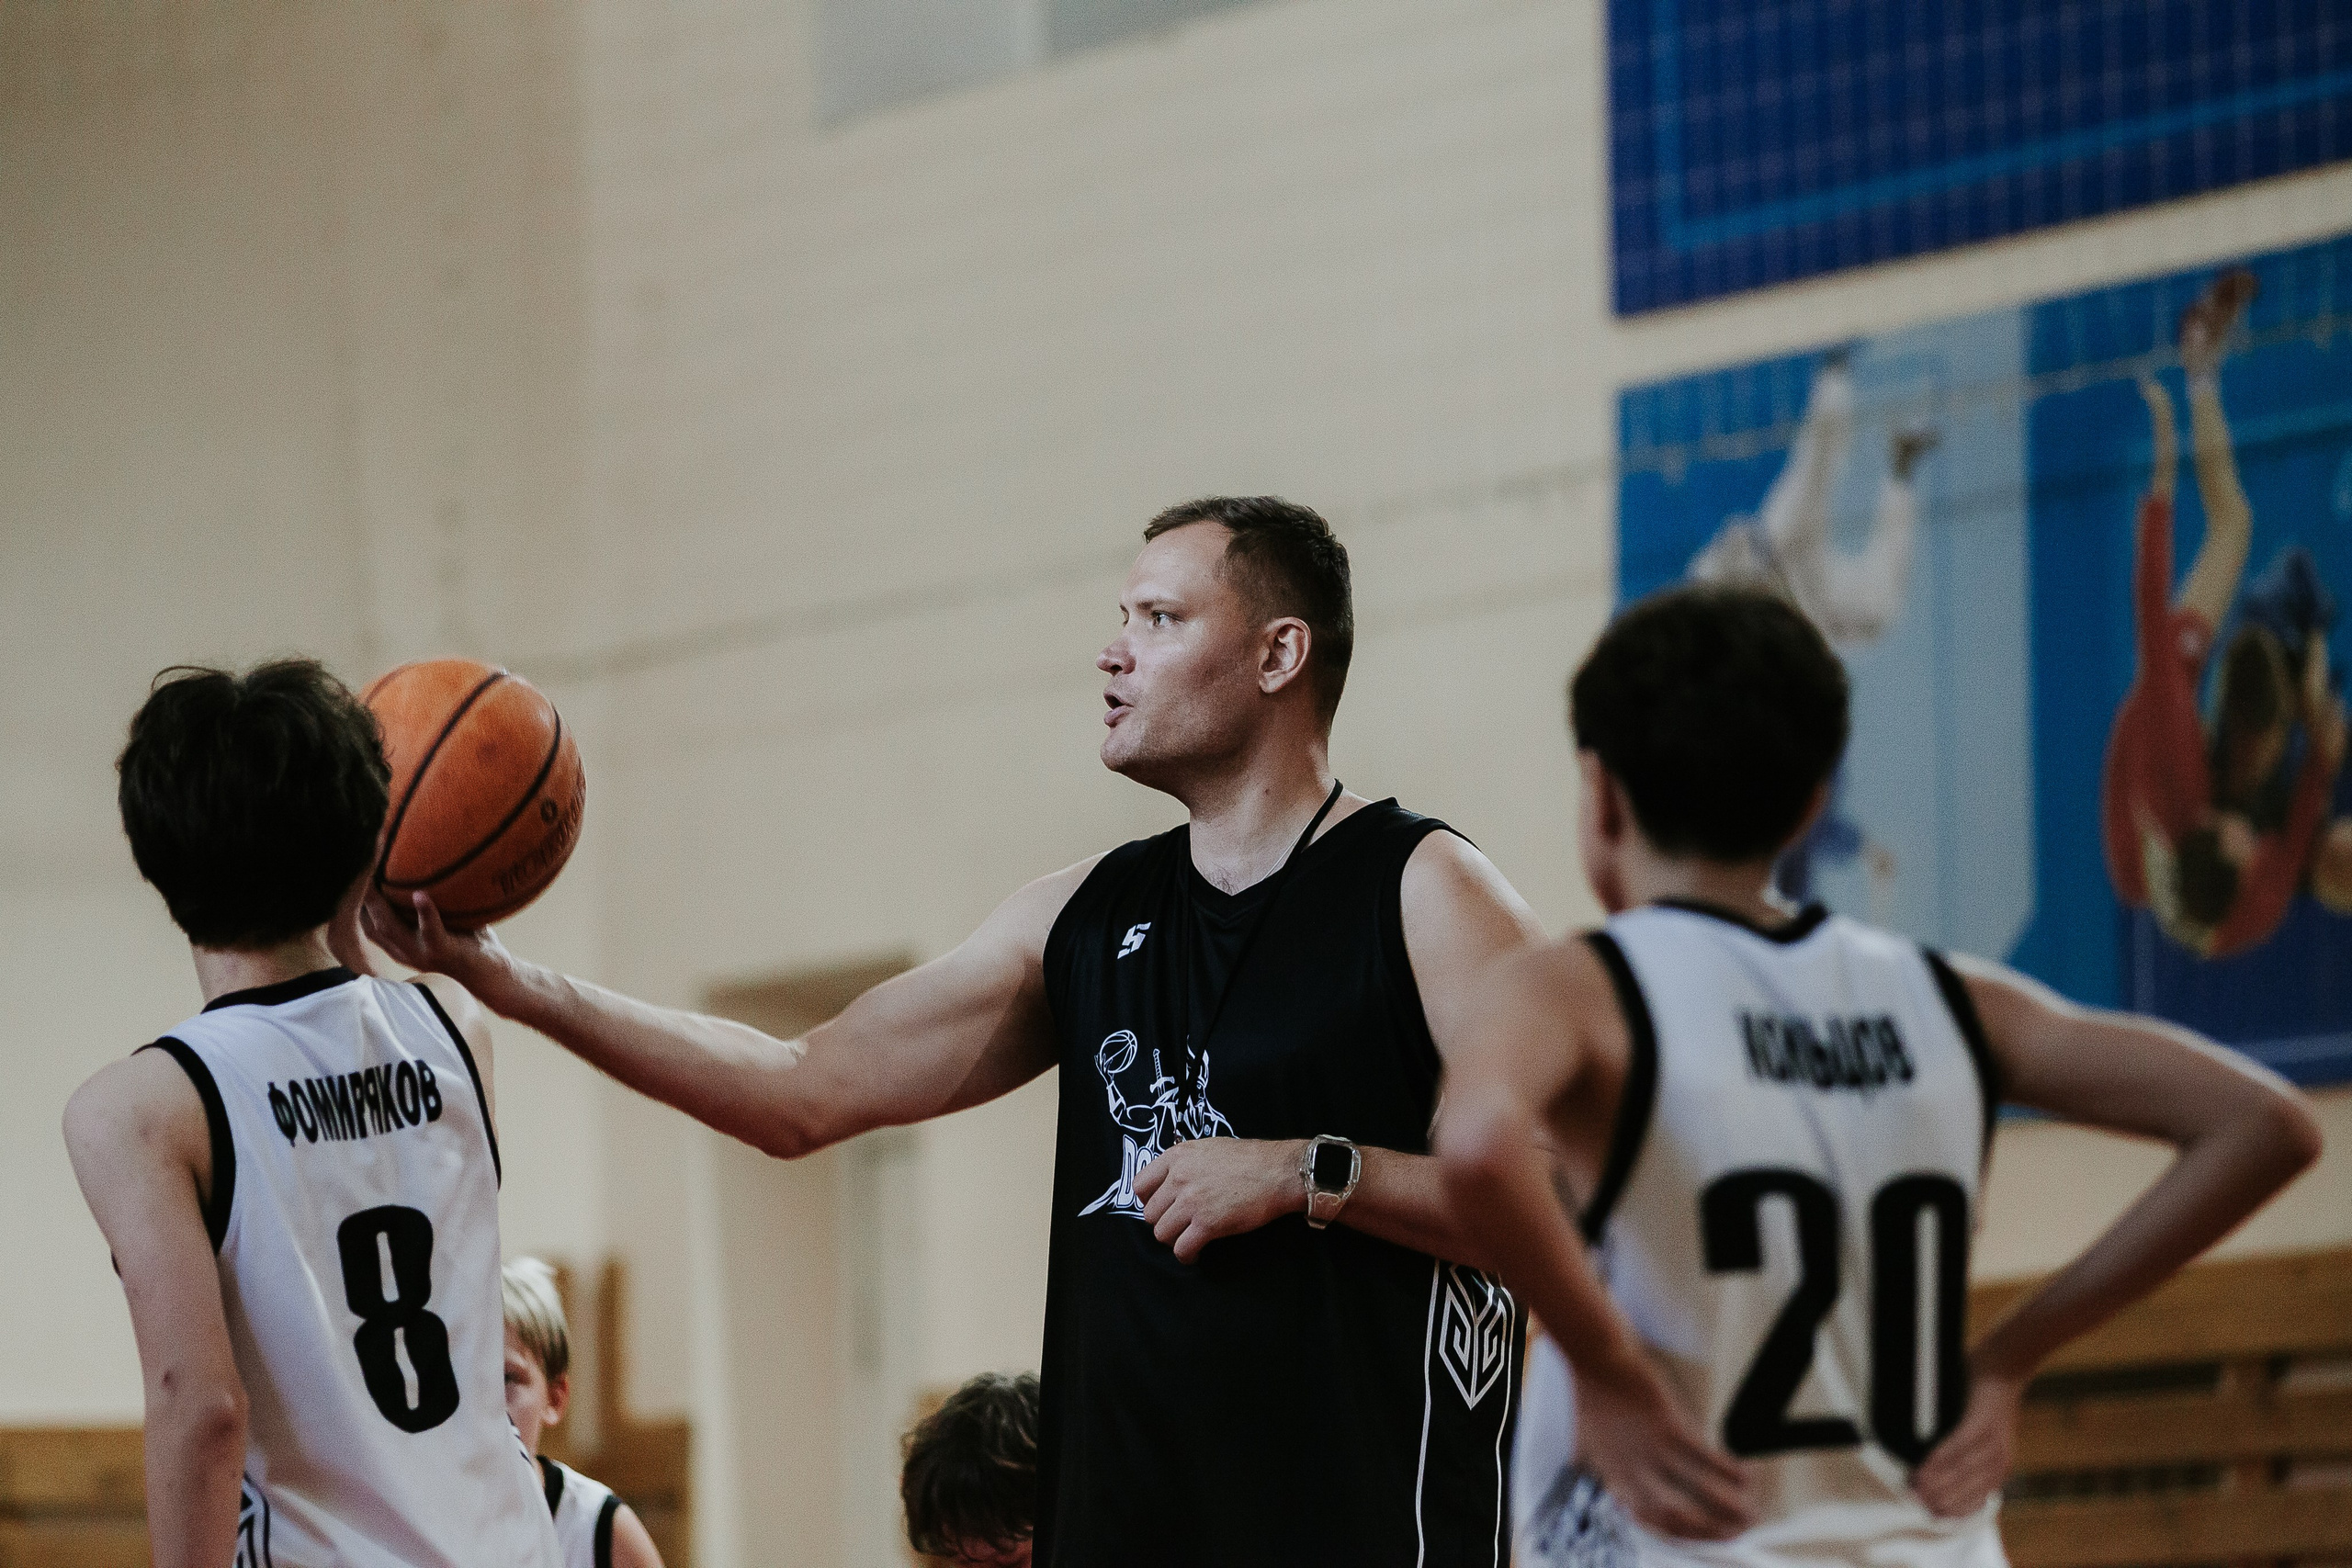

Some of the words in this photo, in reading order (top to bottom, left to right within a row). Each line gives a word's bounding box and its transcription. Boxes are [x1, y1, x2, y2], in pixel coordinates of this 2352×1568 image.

[267, 1060, 443, 1147] ФОМИРЯКОВ
[336, 1204, 460, 1434] 8
[1702, 1168, 1968, 1465] 20
